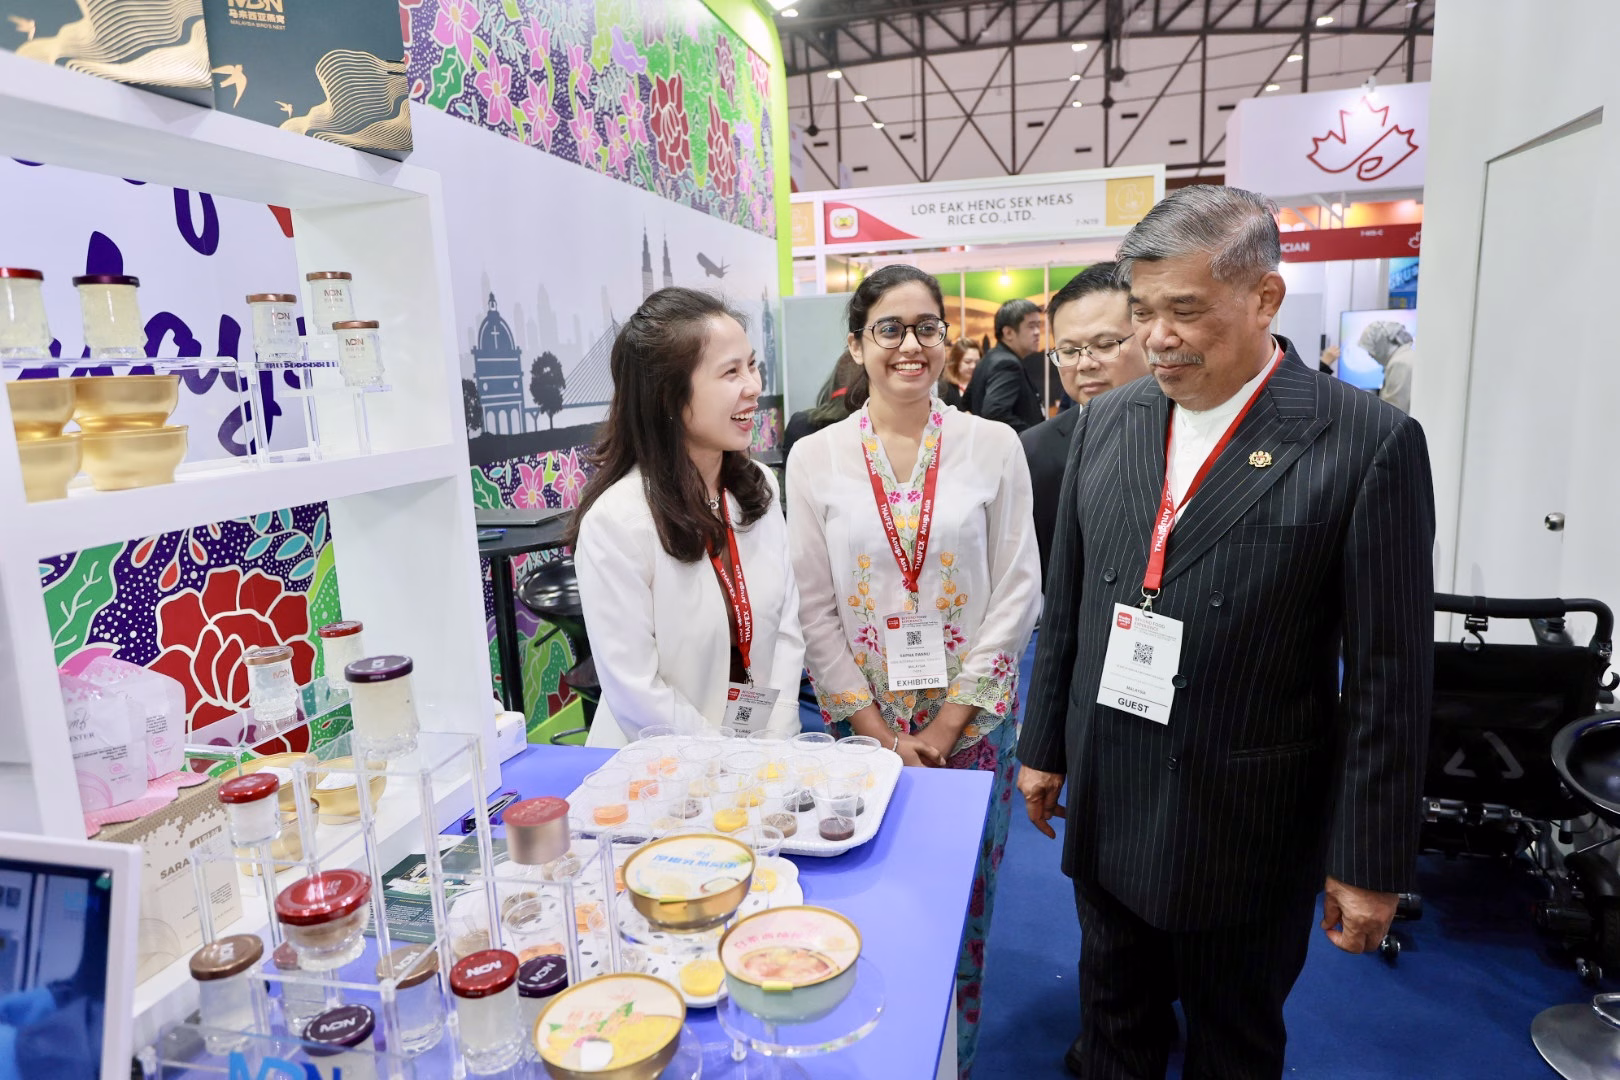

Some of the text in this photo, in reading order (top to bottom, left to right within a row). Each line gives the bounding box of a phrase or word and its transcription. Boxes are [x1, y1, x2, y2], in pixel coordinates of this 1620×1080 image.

[911, 193, 1074, 216] LOR EAK HENG SEK MEAS
[948, 213, 975, 225] RICE
[923, 500, 931, 513] Asia
[920, 514, 930, 535] Anuga
[881, 503, 895, 531] THAIFEX
[891, 536, 902, 557] Anuga
[900, 557, 908, 571] Asia
[914, 541, 925, 570] THAIFEX
[739, 581, 747, 604] Anuga
[743, 610, 751, 643] THAIFEX
[897, 677, 940, 687] EXHIBITOR
[1117, 697, 1150, 713] GUEST
[160, 858, 191, 880] SARA
